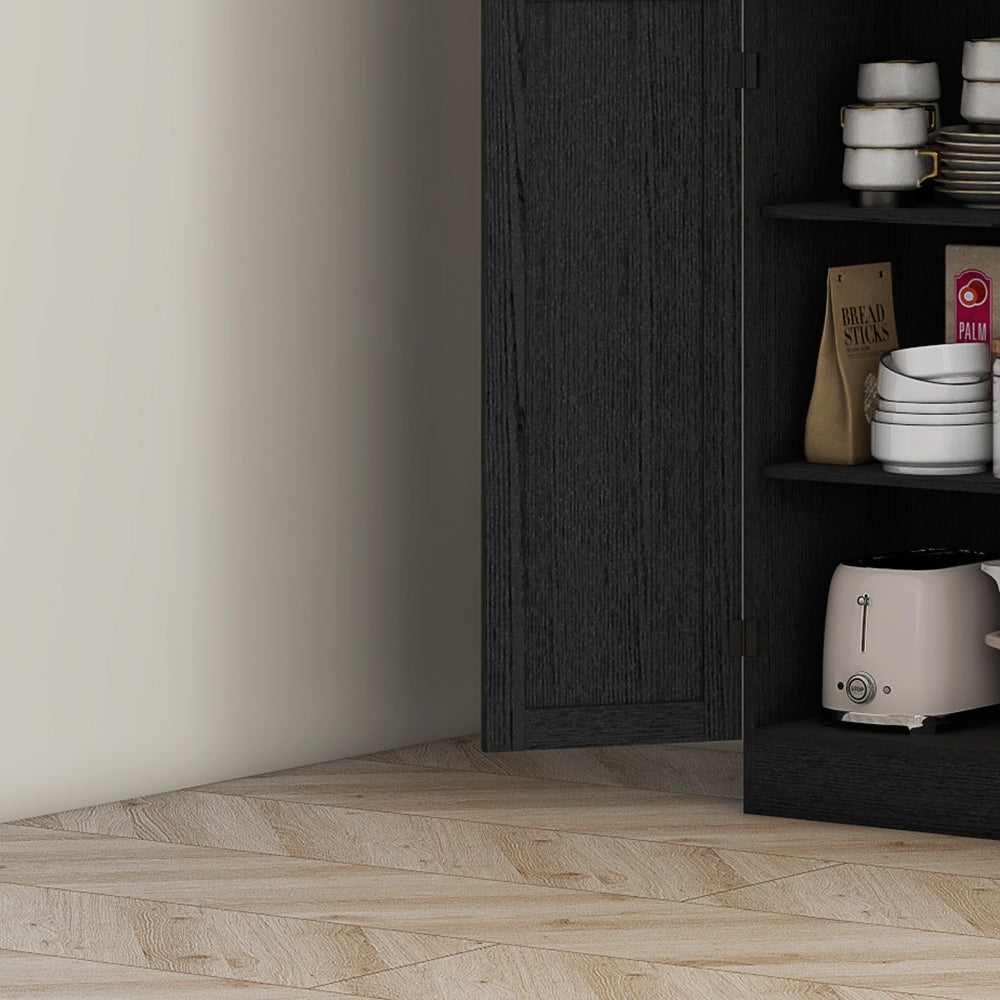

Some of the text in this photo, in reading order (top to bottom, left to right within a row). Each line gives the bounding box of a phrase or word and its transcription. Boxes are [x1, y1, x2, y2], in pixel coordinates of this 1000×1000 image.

[841, 303, 885, 327] BREAD
[843, 323, 890, 346] STICKS
[958, 321, 987, 341] PALM
